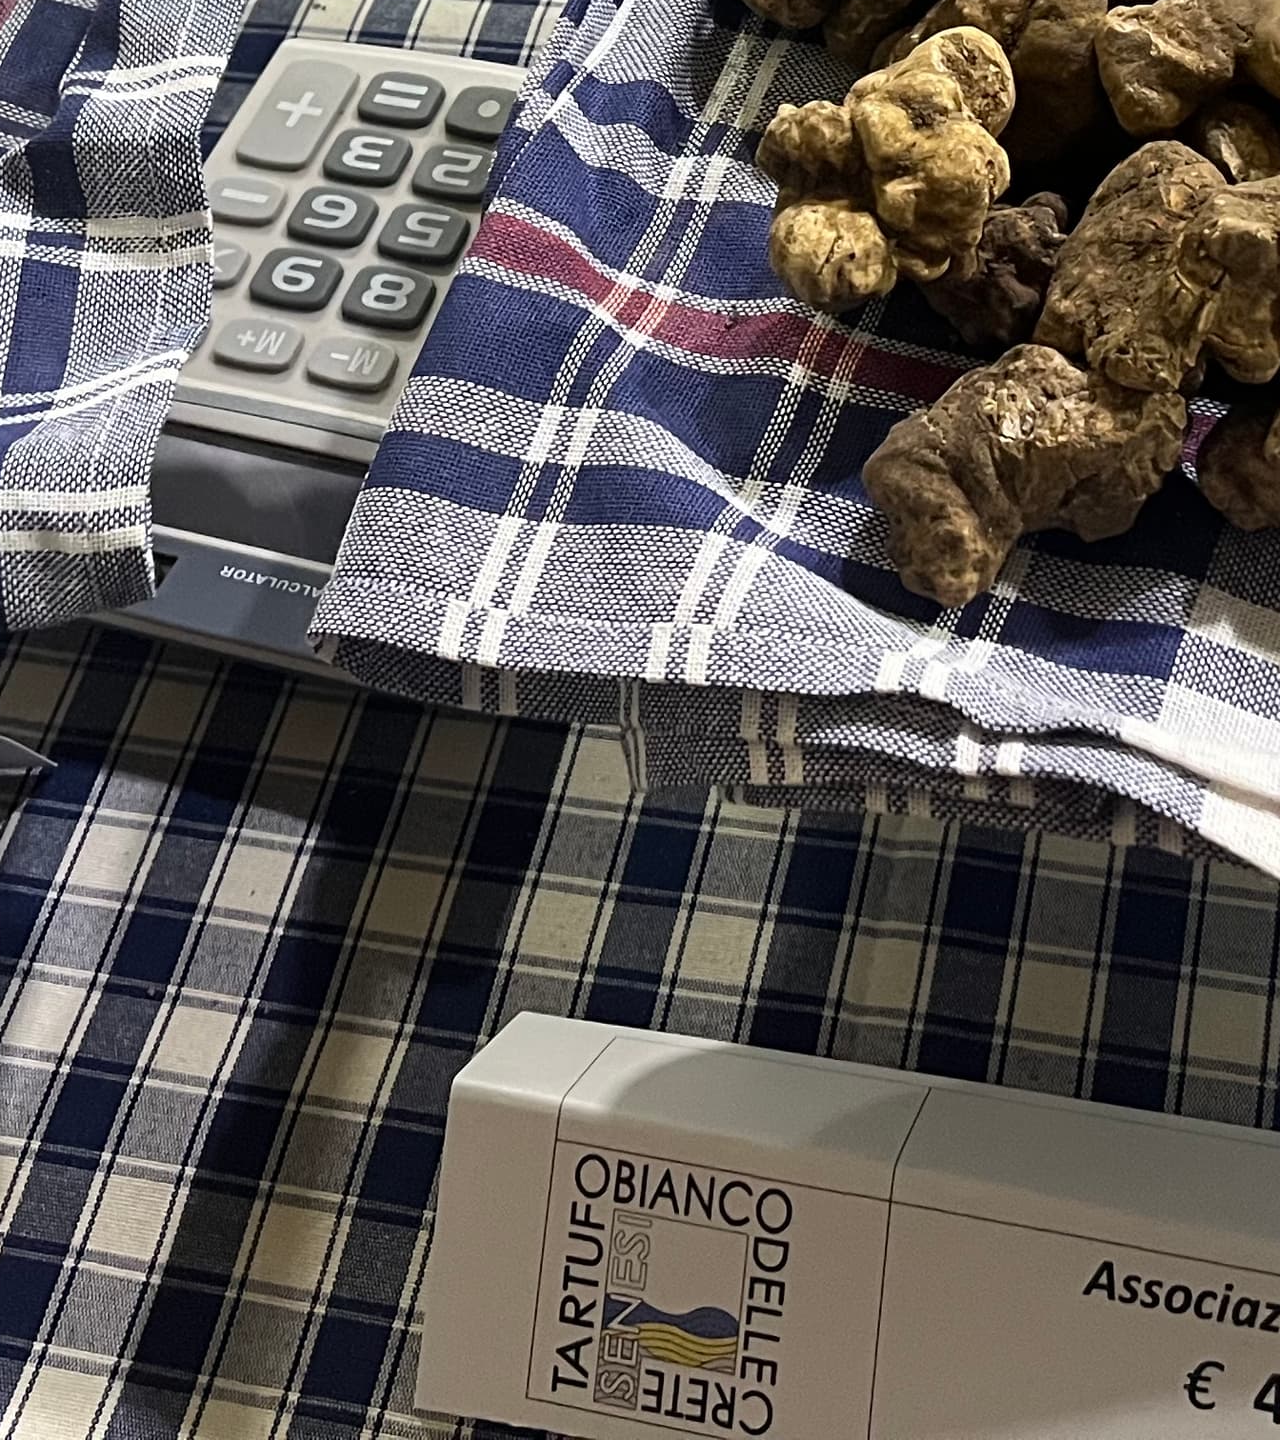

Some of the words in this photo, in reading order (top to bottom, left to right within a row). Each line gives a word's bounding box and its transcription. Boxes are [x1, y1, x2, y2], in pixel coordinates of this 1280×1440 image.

[342, 136, 394, 170] 3
[431, 150, 483, 186] 2
[398, 211, 450, 247] 5
[361, 273, 416, 311] 8
[237, 328, 286, 356] M+
[220, 565, 326, 598] ALCULATOR
[739, 1236, 789, 1386] DELLE
[640, 1368, 774, 1436] CRETE
[1183, 1360, 1225, 1410] €
